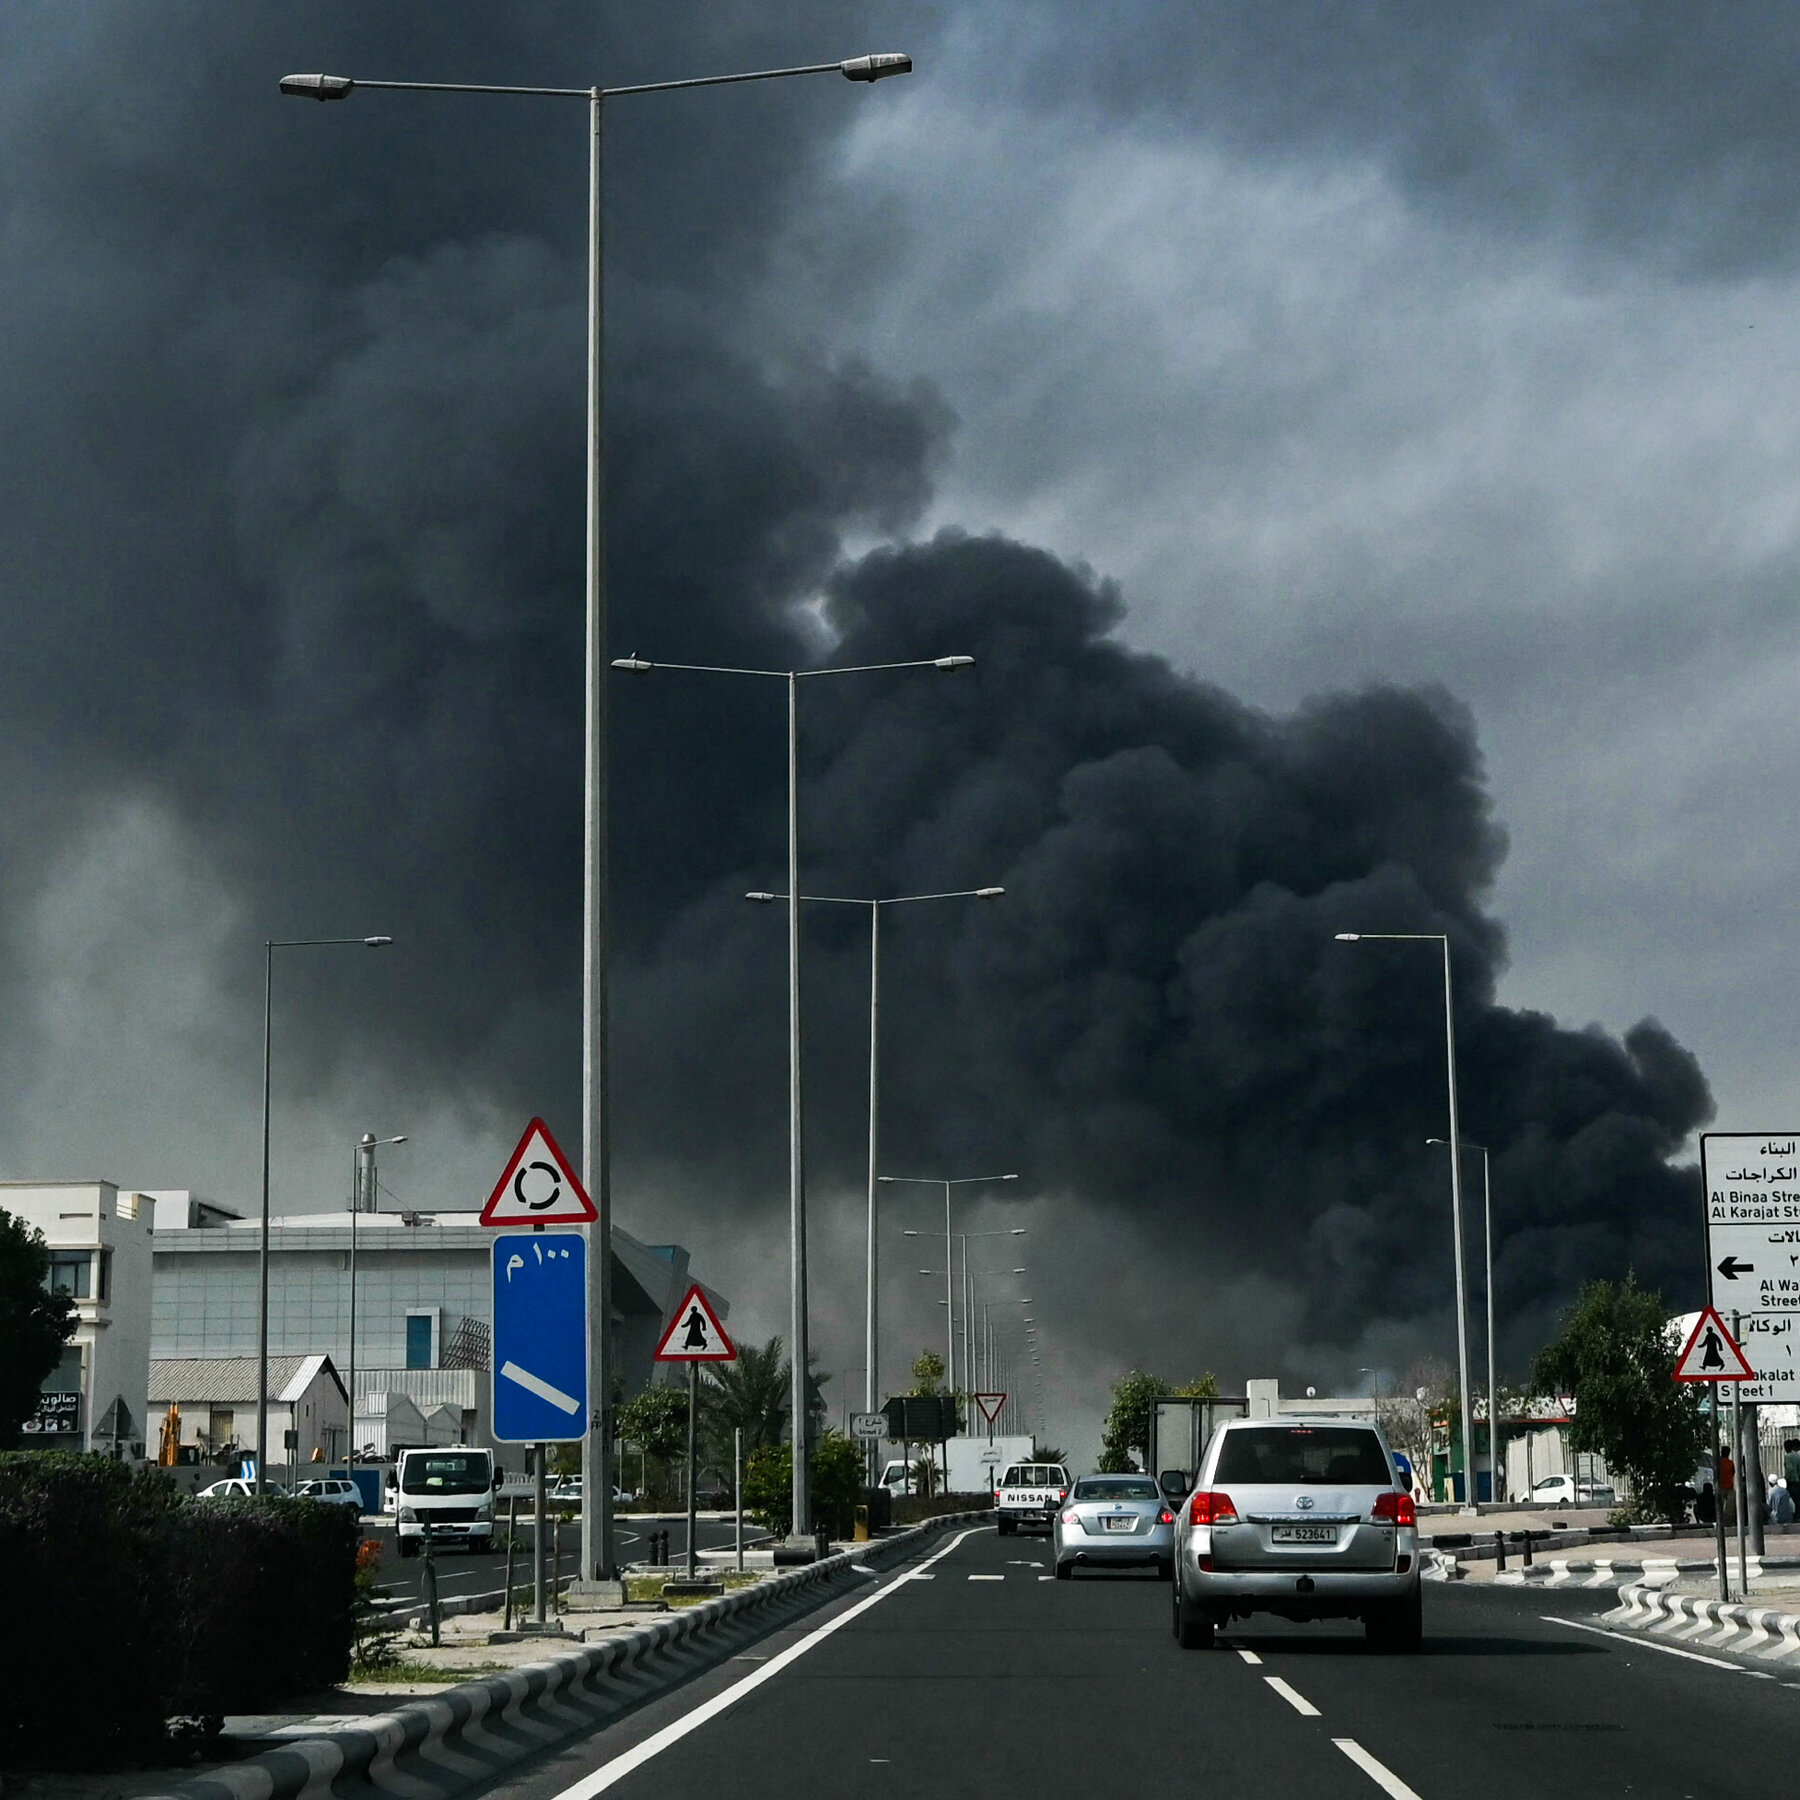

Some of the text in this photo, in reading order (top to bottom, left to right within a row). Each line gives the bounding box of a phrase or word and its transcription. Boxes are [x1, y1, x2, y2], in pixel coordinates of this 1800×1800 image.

[1760, 1141, 1796, 1158] البناء
[1726, 1166, 1797, 1183] الكراجات
[1711, 1191, 1725, 1203] Al
[1730, 1191, 1768, 1203] Binaa
[1712, 1206, 1800, 1220] Al Karajat St
[506, 1241, 569, 1283] ١٠٠ م
[1760, 1279, 1800, 1291] Al Wa
[1752, 1368, 1795, 1381] akalat
[1721, 1384, 1773, 1397] Sreet 1
[41, 1393, 76, 1406] صالون
[1007, 1493, 1053, 1502] NISSAN
[1295, 1529, 1330, 1540] 523641
